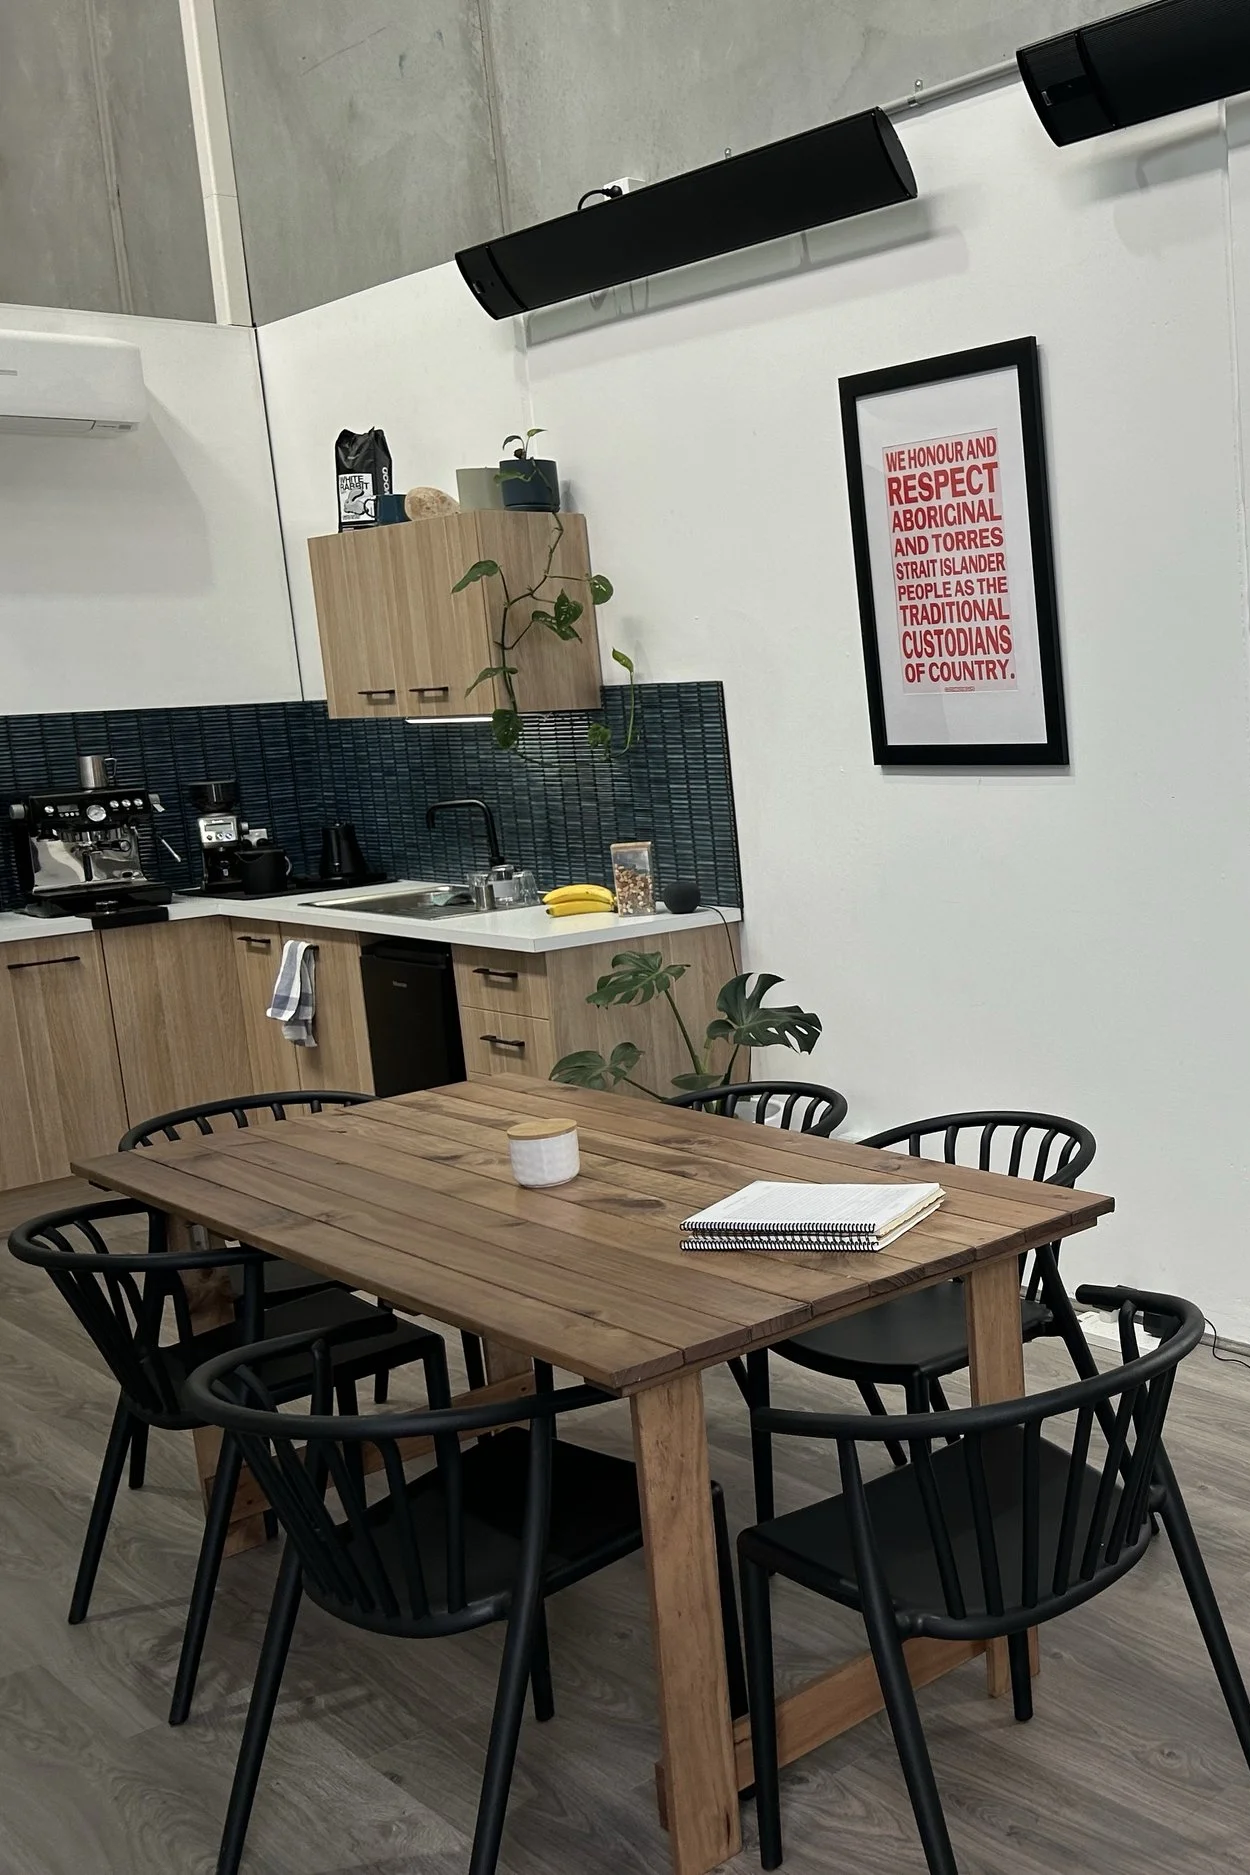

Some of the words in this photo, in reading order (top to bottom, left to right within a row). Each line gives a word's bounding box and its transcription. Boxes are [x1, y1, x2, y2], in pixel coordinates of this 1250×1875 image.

[886, 450, 906, 472] WE
[908, 441, 964, 469] HONOUR
[966, 435, 997, 461] AND
[887, 461, 998, 506] RESPECT
[892, 498, 1002, 533] ABORIGINAL
[894, 535, 929, 557] AND
[932, 526, 1004, 553] TORRES
[896, 559, 938, 580] STRAIT
[940, 553, 1006, 577] ISLANDER
[898, 581, 952, 601] PEOPLE
[954, 579, 974, 597] AS
[977, 576, 1008, 594] THE
[900, 598, 1009, 626] TRADITIONAL
[902, 624, 1012, 659] CUSTODIANS
[904, 663, 925, 683] OF
[928, 659, 1015, 682] COUNTRY.
